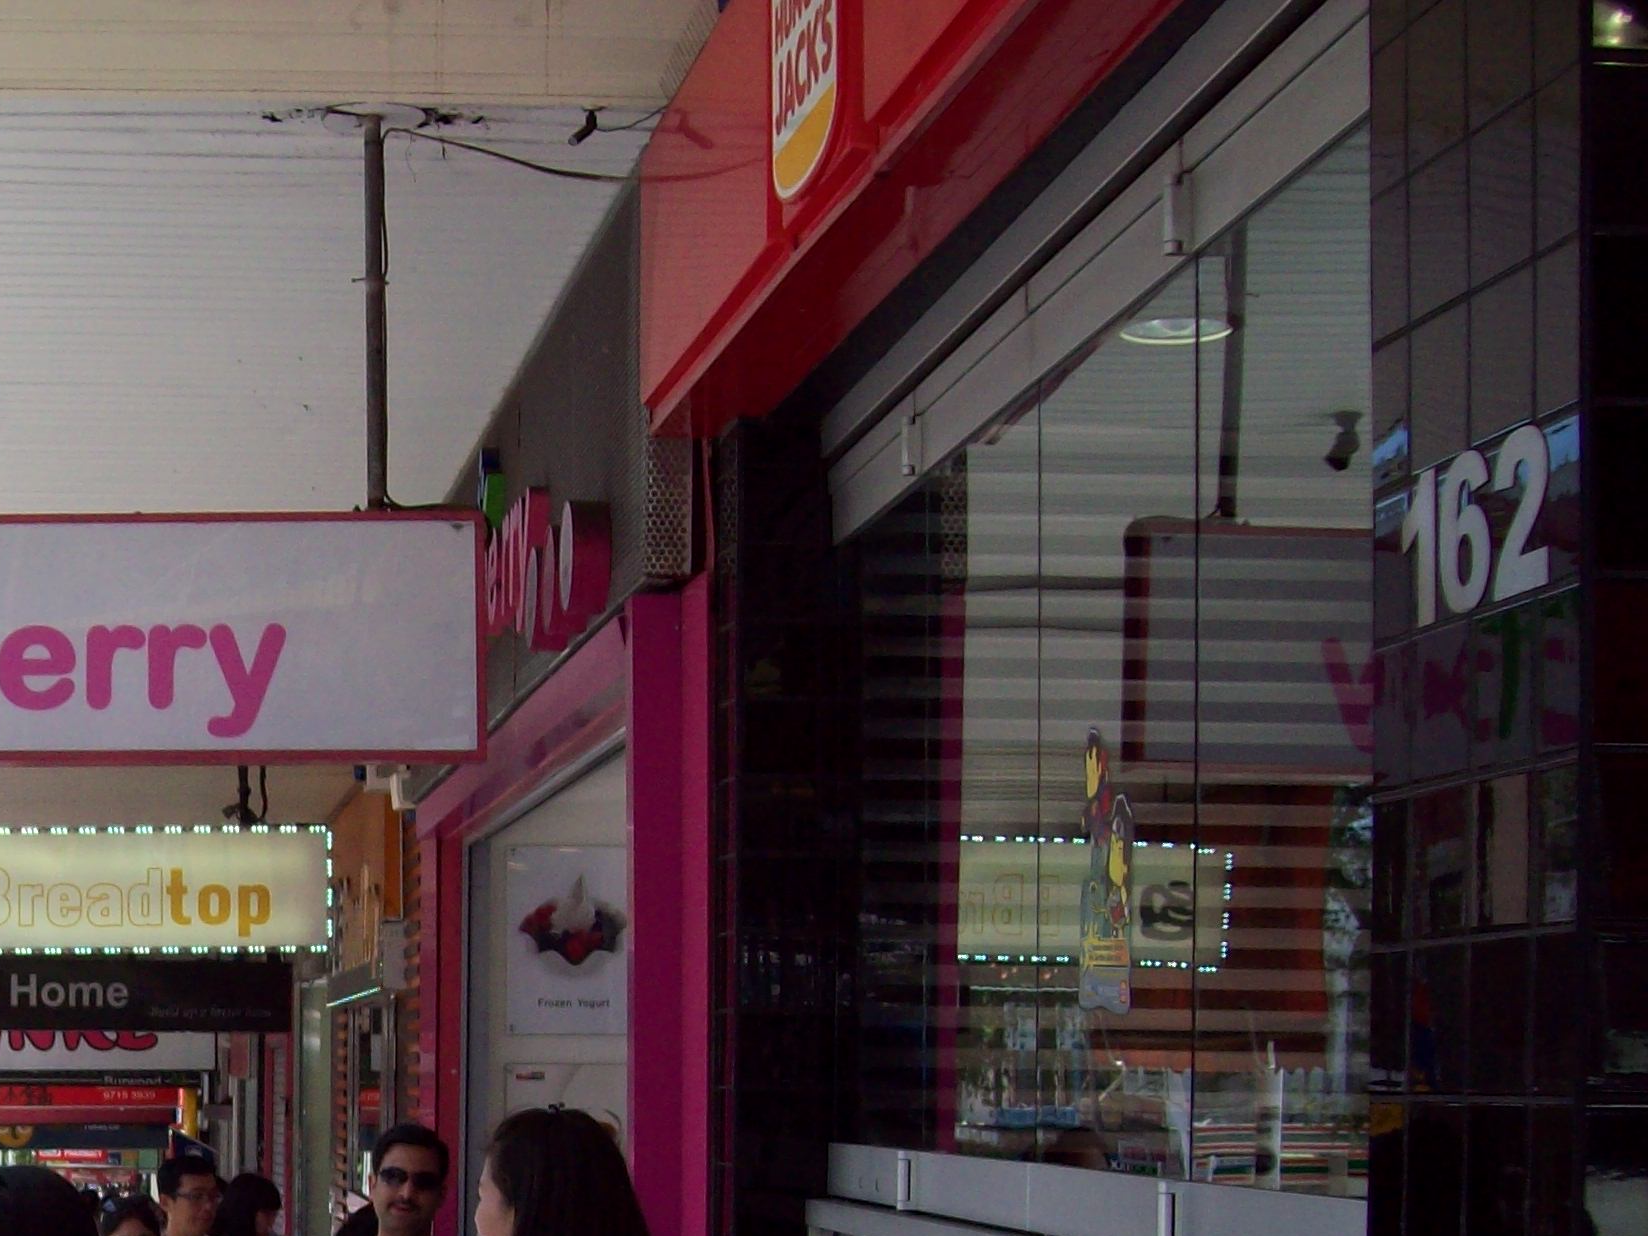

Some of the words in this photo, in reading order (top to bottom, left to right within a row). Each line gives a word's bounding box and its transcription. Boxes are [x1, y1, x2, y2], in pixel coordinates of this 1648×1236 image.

[1402, 424, 1551, 629] 162
[10, 972, 129, 1008] Home
[537, 998, 573, 1008] Frozen
[577, 998, 611, 1010] Yogurt
